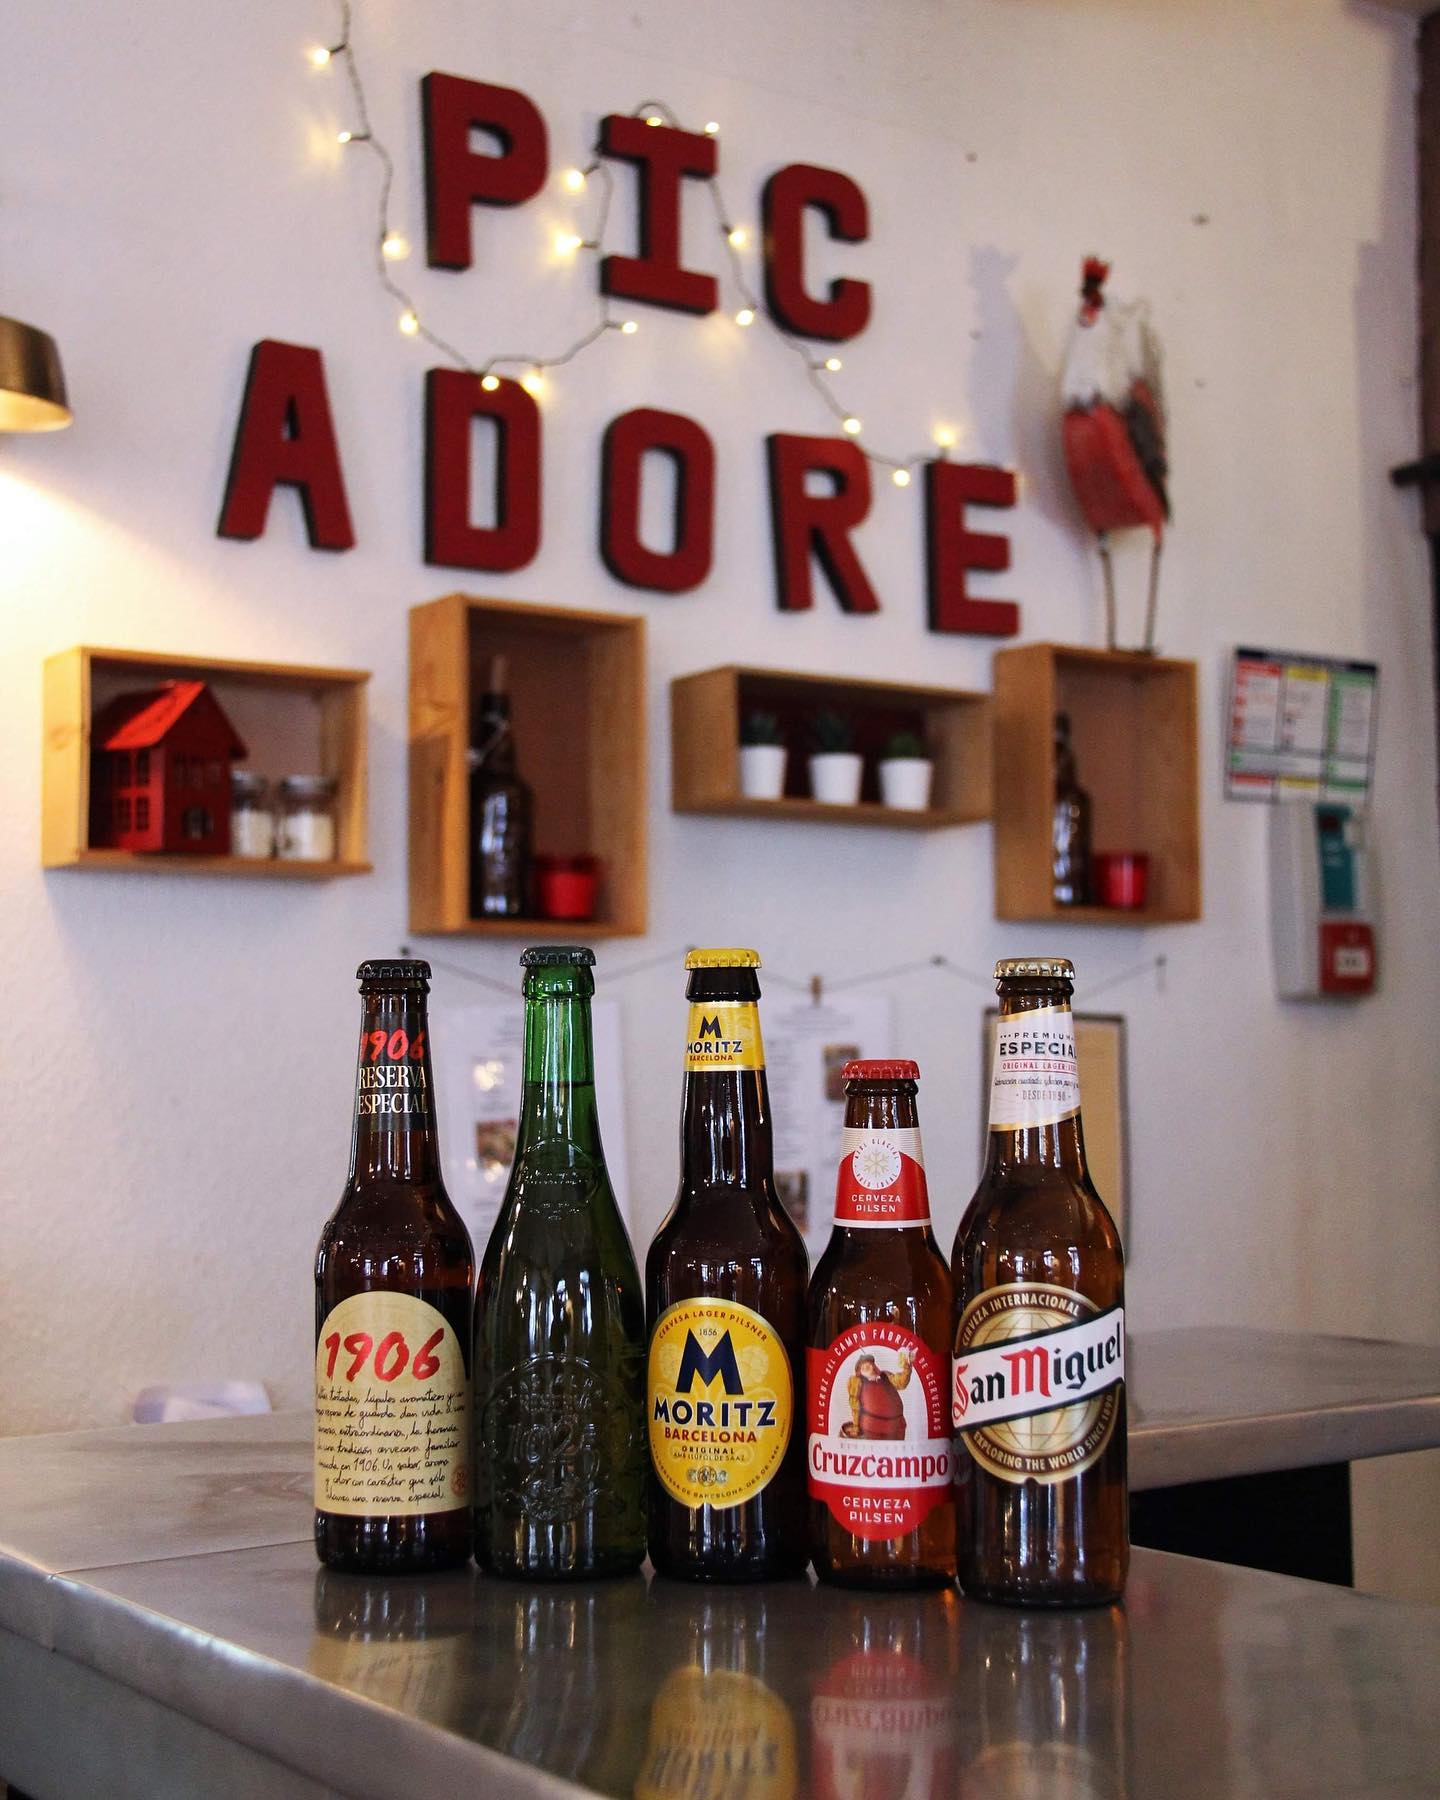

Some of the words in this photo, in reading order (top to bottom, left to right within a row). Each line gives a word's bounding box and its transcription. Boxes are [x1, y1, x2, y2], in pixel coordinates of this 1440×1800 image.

[421, 72, 872, 343] PIC
[217, 339, 1020, 636] ADORE
[699, 1015, 722, 1039] M
[360, 1027, 426, 1062] 1906
[1013, 1032, 1072, 1041] PREMIUM
[687, 1041, 743, 1055] MORITZ
[689, 1054, 733, 1062] BARCELONA
[1002, 1063, 1038, 1071] ORIGINAL
[1043, 1063, 1066, 1071] LAGER
[359, 1065, 427, 1090] RESERVA
[358, 1092, 428, 1115] ESPECIAL
[851, 1194, 902, 1204] CERVEZA
[856, 1204, 897, 1213] PILSEN
[658, 1312, 690, 1340] CERVESA
[692, 1310, 726, 1320] LAGER
[729, 1313, 768, 1342] PILSNER
[961, 1305, 989, 1347] CERVEZA
[989, 1292, 1080, 1317] INTERNACIONAL
[699, 1328, 719, 1337] 1856
[833, 1328, 868, 1358] CAMPO
[324, 1327, 445, 1383] 1906
[675, 1327, 744, 1396] M
[918, 1356, 929, 1370] DE
[824, 1357, 837, 1375] DEL
[951, 1362, 1006, 1421] San
[1000, 1321, 1122, 1398] Miguel
[818, 1377, 830, 1408] CRUZ
[925, 1372, 942, 1433] CERVEZAS
[399, 1406, 417, 1419] dan
[653, 1396, 777, 1428] MORITZ
[816, 1413, 825, 1428] LA
[410, 1421, 422, 1436] la
[664, 1427, 758, 1444] BARCELONA
[681, 1445, 735, 1455] ORIGINAL
[973, 1431, 1023, 1471] EXPLORING
[1025, 1457, 1046, 1471] THE
[1048, 1445, 1086, 1469] WORLD
[1085, 1421, 1105, 1450] SINCE
[383, 1458, 393, 1471] Un
[811, 1439, 949, 1483] Cruzcampo
[409, 1478, 425, 1493] que
[842, 1495, 911, 1510] CERVEZA
[849, 1511, 905, 1524] PILSEN
